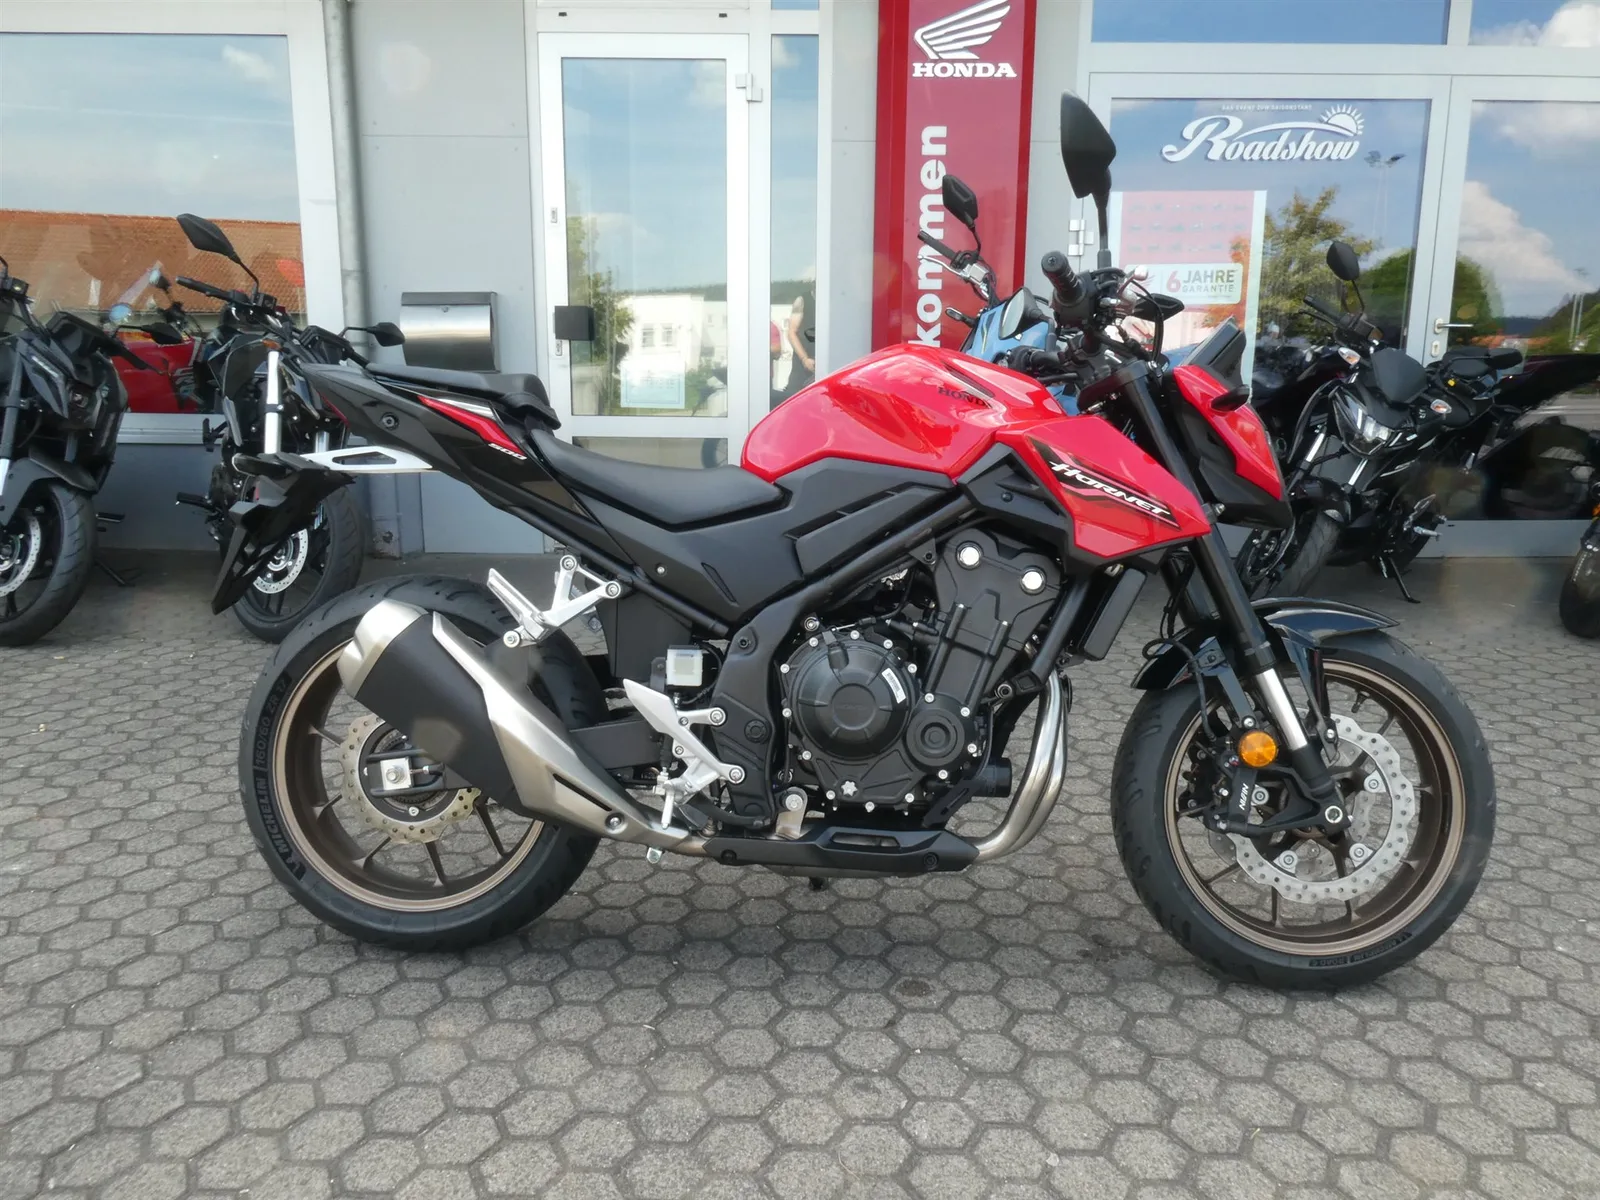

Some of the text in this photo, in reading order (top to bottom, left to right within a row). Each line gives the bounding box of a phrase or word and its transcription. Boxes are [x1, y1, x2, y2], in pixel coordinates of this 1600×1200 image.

[912, 62, 1017, 78] HONDA
[1162, 114, 1361, 162] Roadshow
[1166, 269, 1236, 293] 6 JAHRE
[1182, 284, 1235, 293] GARANTIE
[1049, 460, 1171, 515] HORNET
[255, 716, 271, 767] 160/60
[256, 777, 293, 855] MICHELIN
